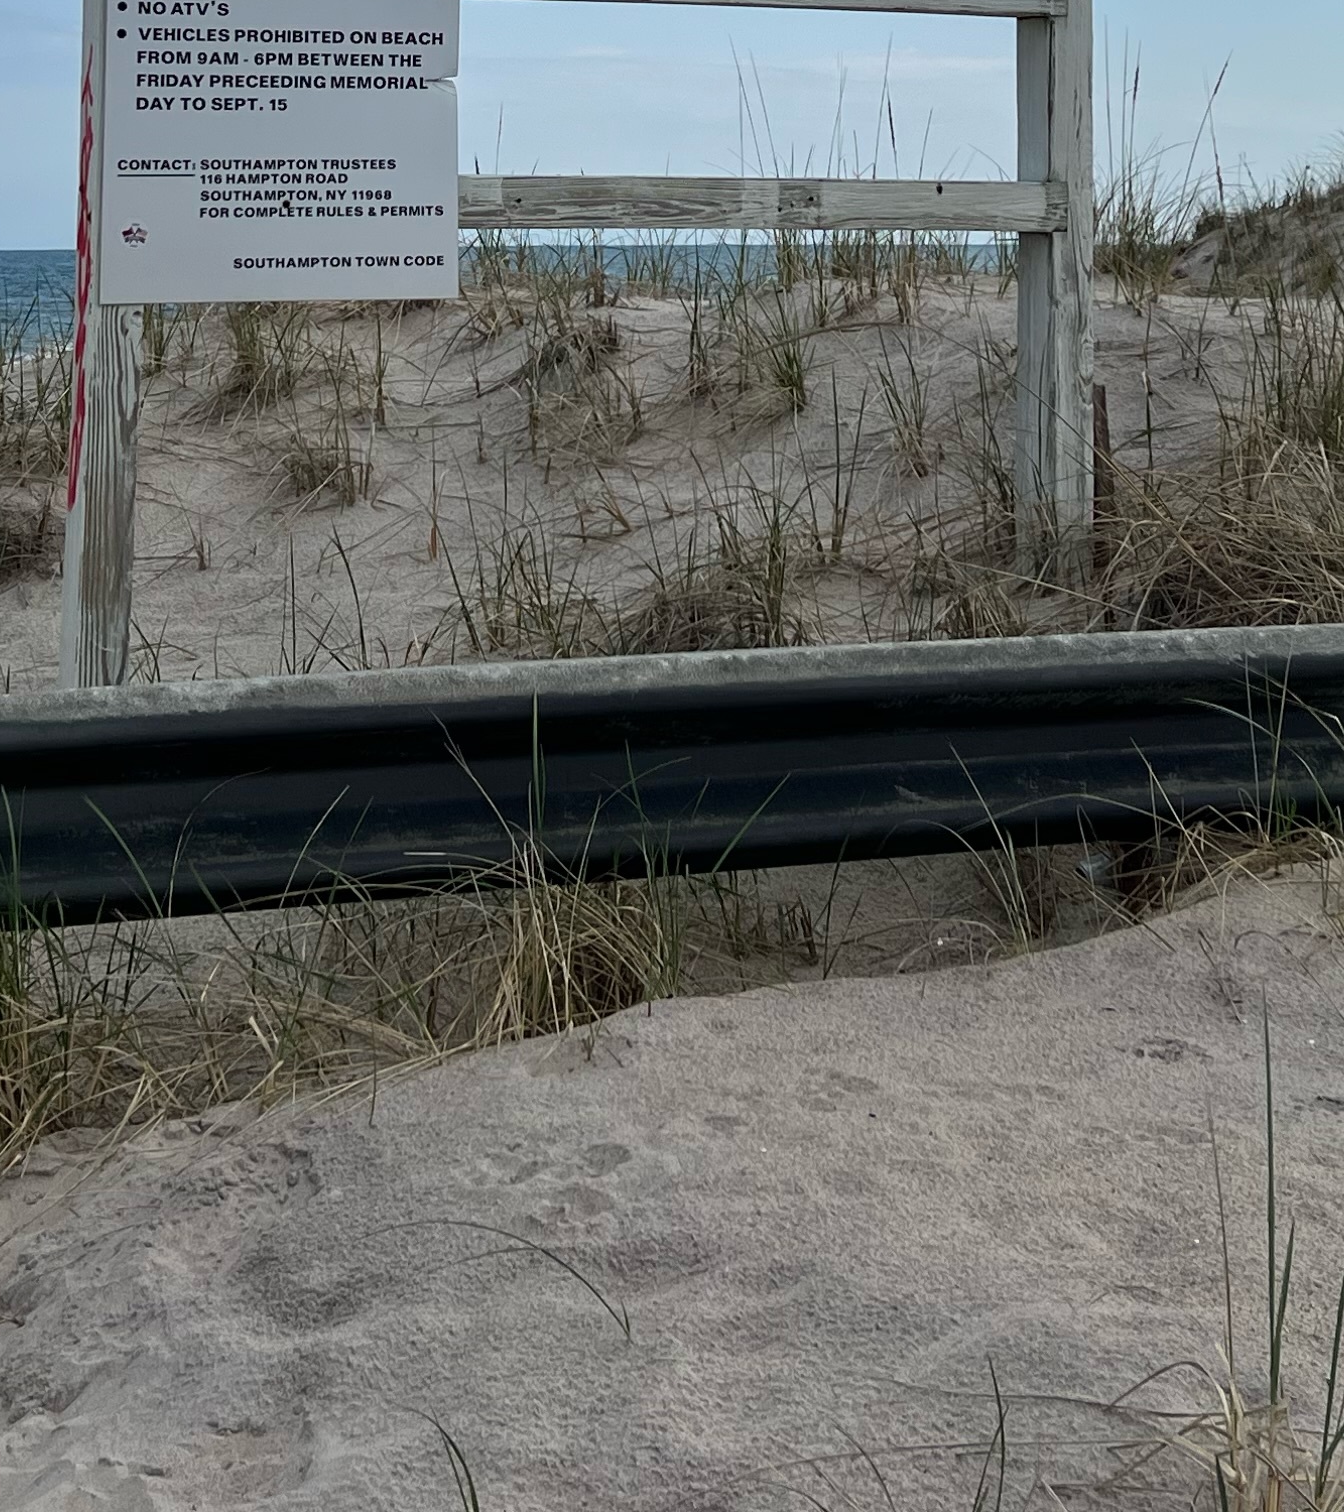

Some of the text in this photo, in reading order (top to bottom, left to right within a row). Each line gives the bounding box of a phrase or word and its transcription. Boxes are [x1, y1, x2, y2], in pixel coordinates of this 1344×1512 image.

[138, 1, 229, 16] NO ATV'S
[138, 27, 443, 45] VEHICLES PROHIBITED ON BEACH
[137, 51, 191, 64] FROM
[198, 52, 238, 65] 9AM
[254, 53, 292, 66] 6PM
[298, 53, 383, 66] BETWEEN
[388, 54, 422, 67] THE
[137, 74, 429, 89] FRIDAY PRECEEDING MEMORIAL
[136, 97, 287, 111] DAY TO SEPT. 15
[118, 159, 396, 170] CONTACT: SOUTHAMPTON TRUSTEES
[200, 173, 348, 184] 116 HAMPTON ROAD
[200, 190, 391, 201] SOUTHAMPTON, NY 11968
[200, 206, 443, 218] FOR COMPLETE RULES & PERMITS
[234, 256, 444, 269] SOUTHAMPTON TOWN CODE
